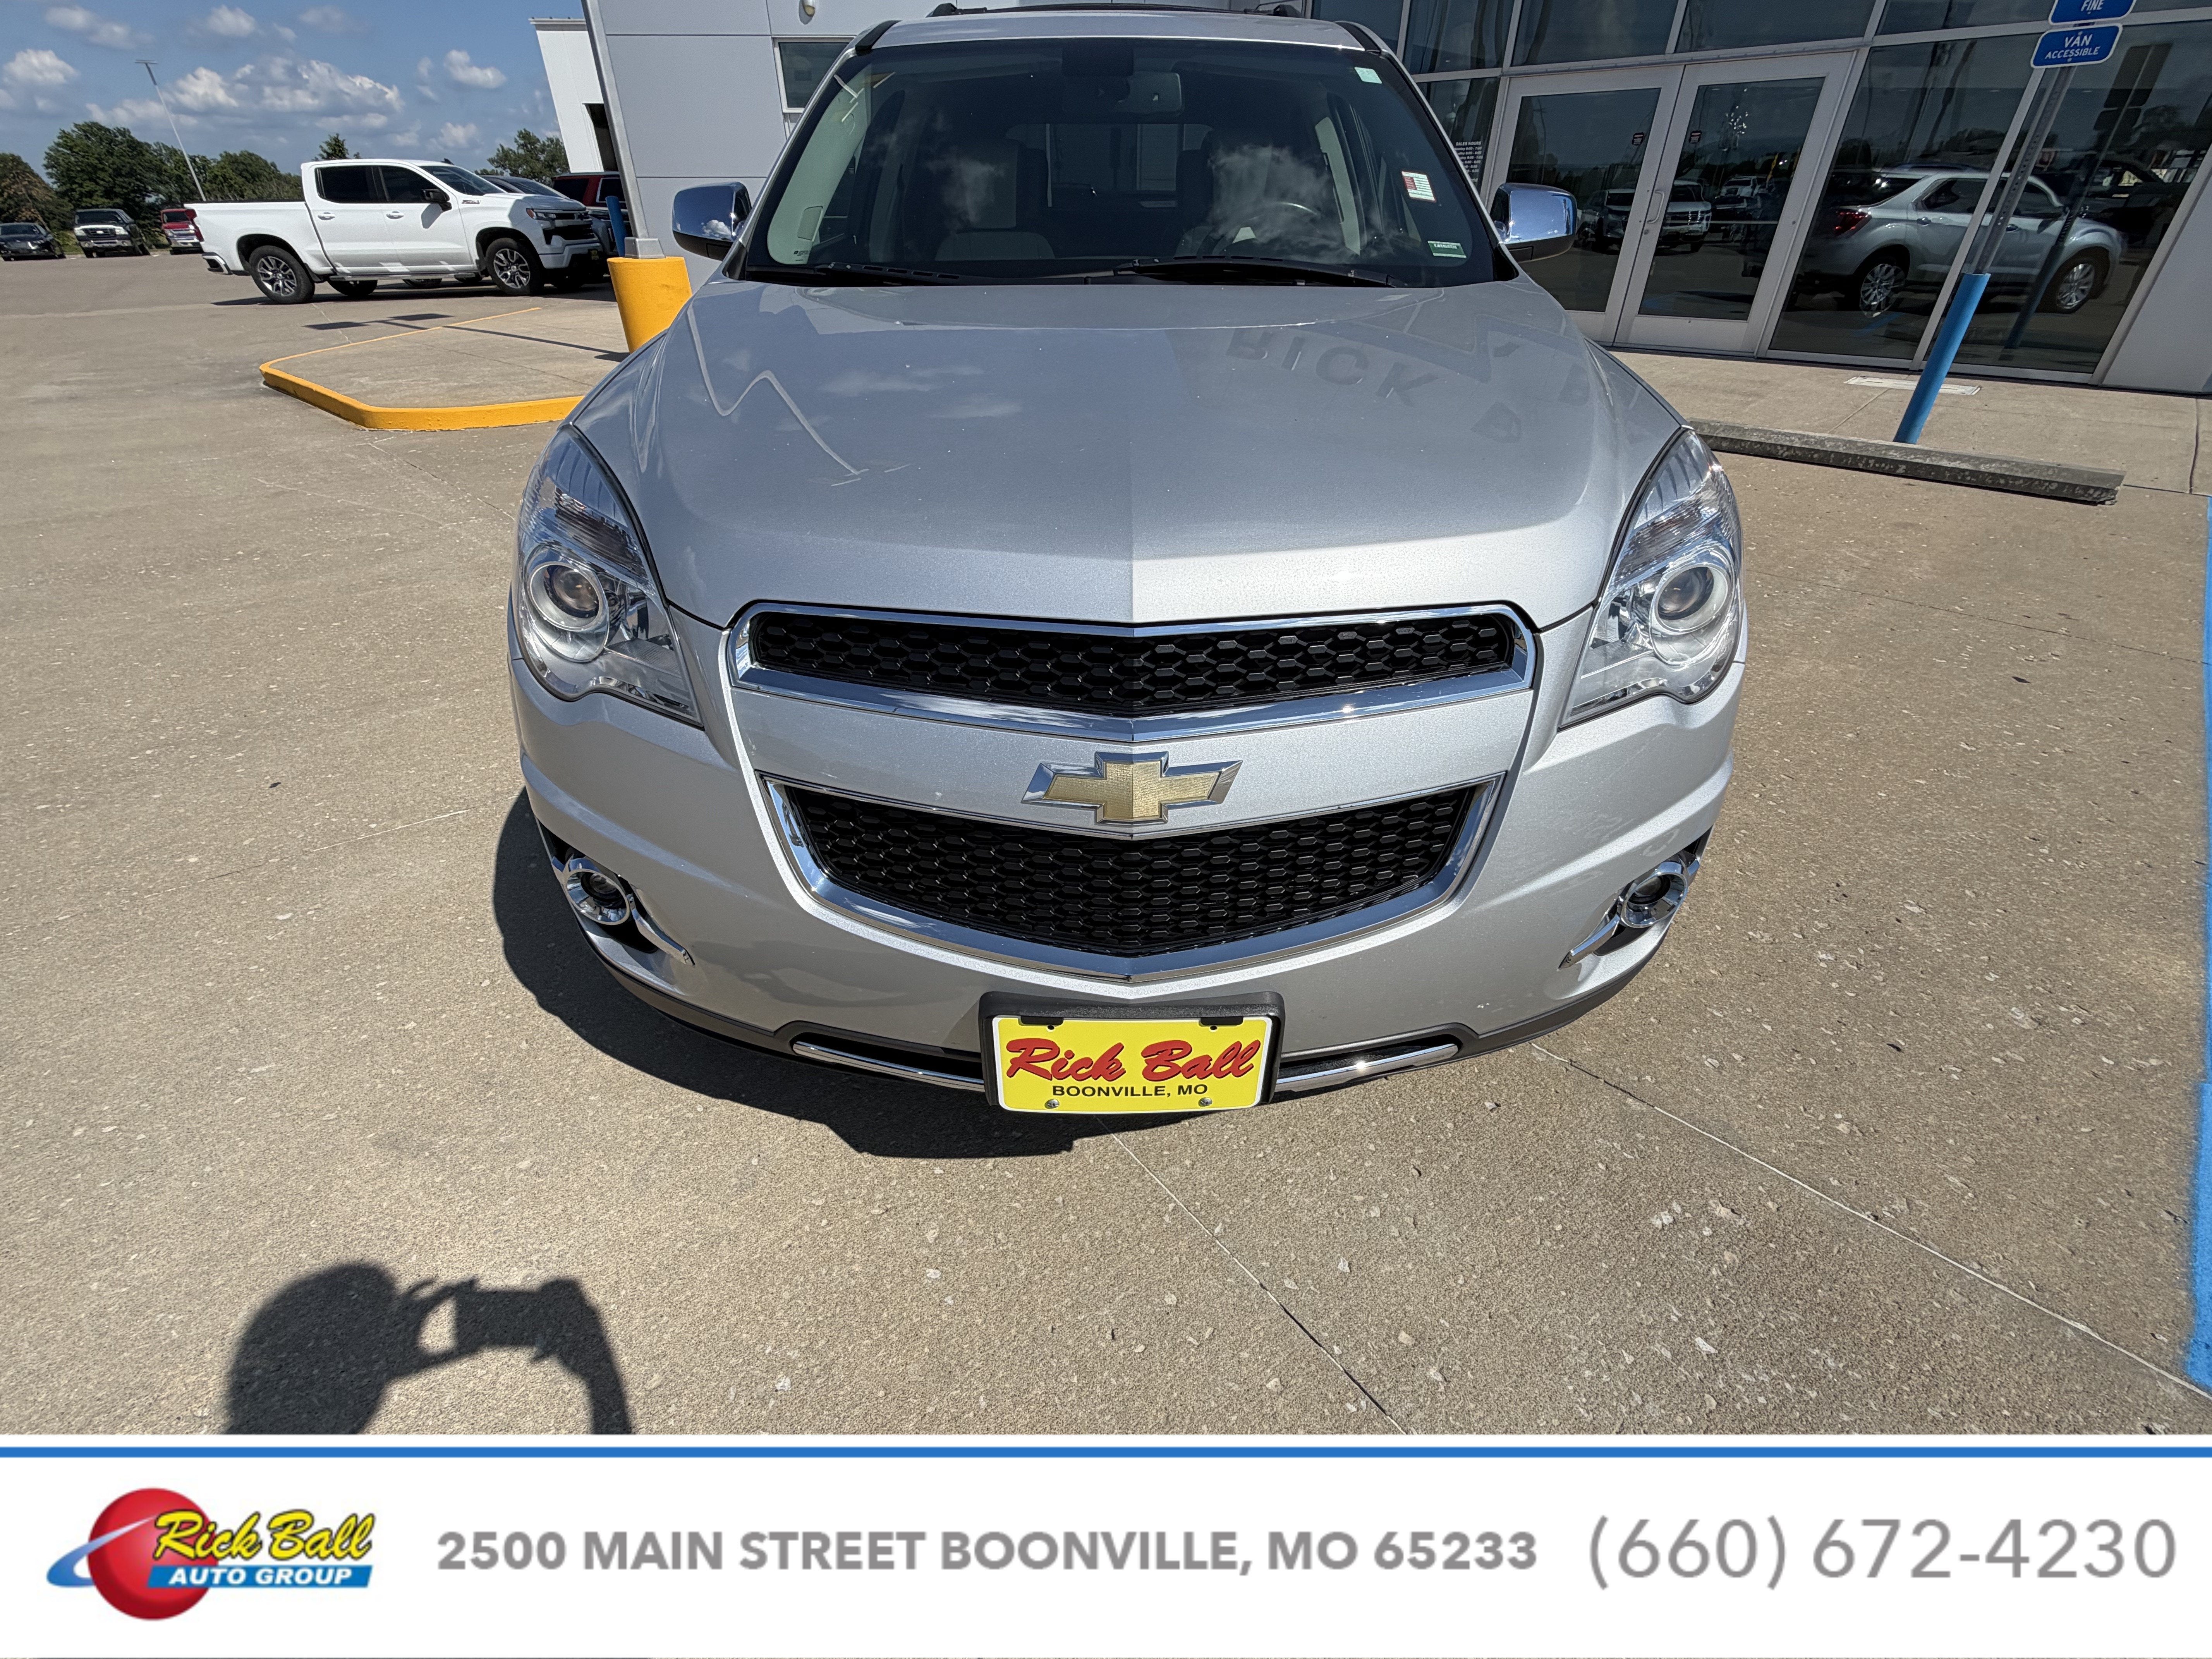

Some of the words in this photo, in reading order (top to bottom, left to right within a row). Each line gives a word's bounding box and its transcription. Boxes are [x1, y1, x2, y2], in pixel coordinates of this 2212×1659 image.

[2081, 0, 2104, 11] FINE
[2064, 34, 2093, 48] VAN
[2045, 46, 2101, 59] ACCESSIBLE
[1006, 1038, 1126, 1082] Rick
[1140, 1039, 1260, 1082] Ball
[1053, 1085, 1171, 1098] BOONVILLE,
[1177, 1084, 1208, 1095] MO
